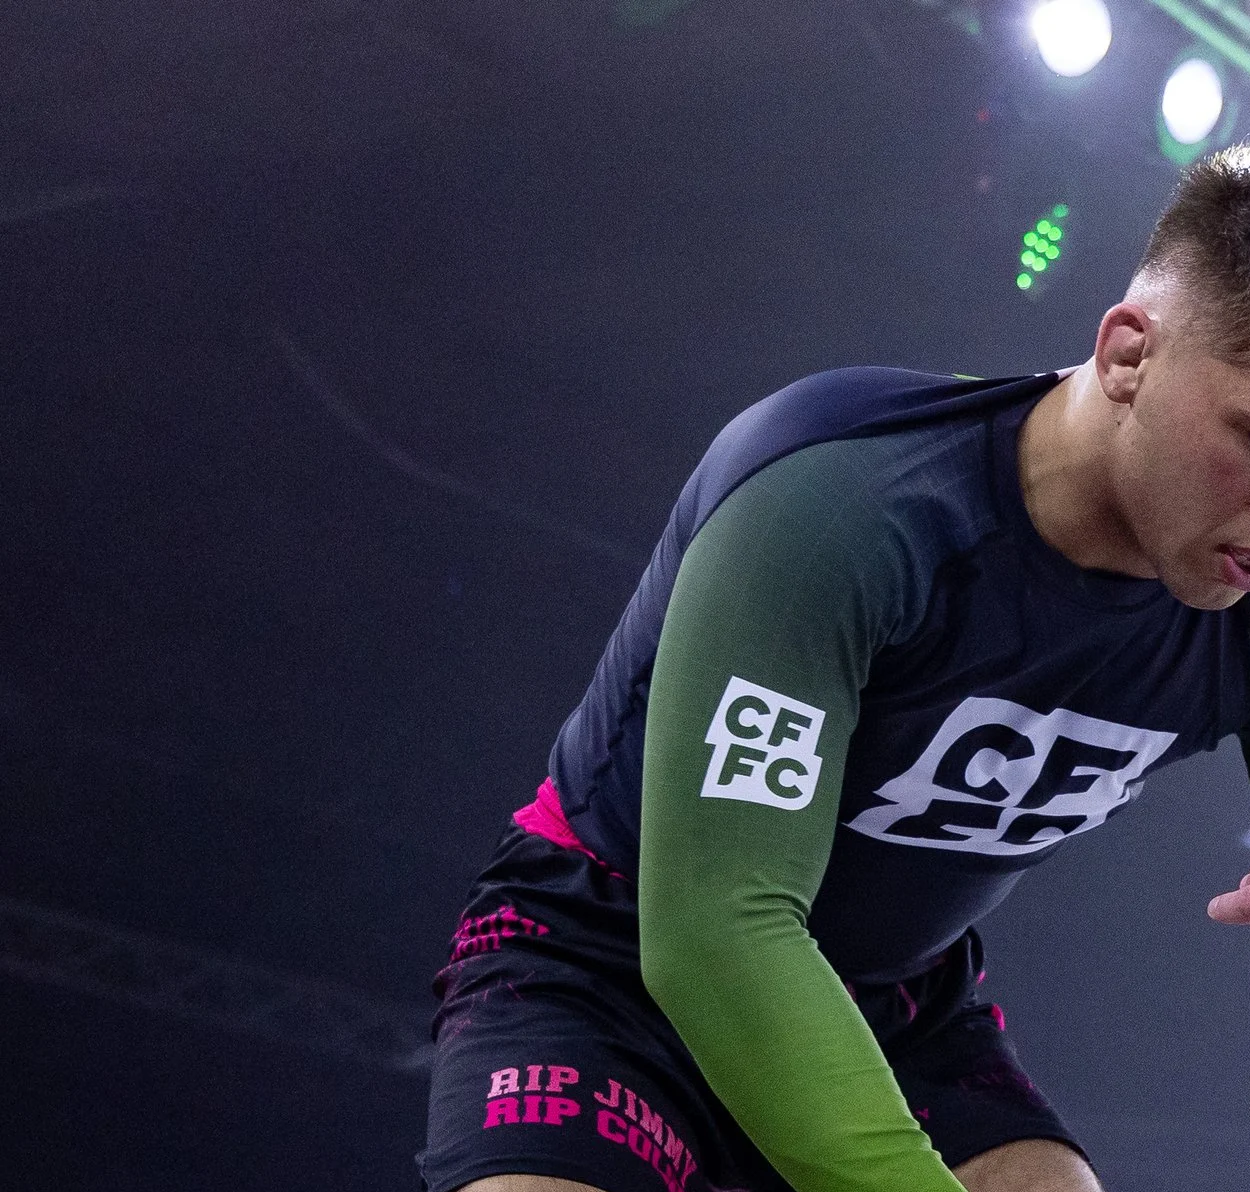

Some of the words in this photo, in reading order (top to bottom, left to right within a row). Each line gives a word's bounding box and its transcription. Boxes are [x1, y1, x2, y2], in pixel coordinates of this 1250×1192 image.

[725, 694, 811, 748] CF
[715, 742, 809, 800] FC
[931, 723, 1139, 810] CF
[482, 1095, 582, 1129] RIP
[486, 1064, 580, 1100] RIP
[593, 1077, 698, 1189] JIMMY
